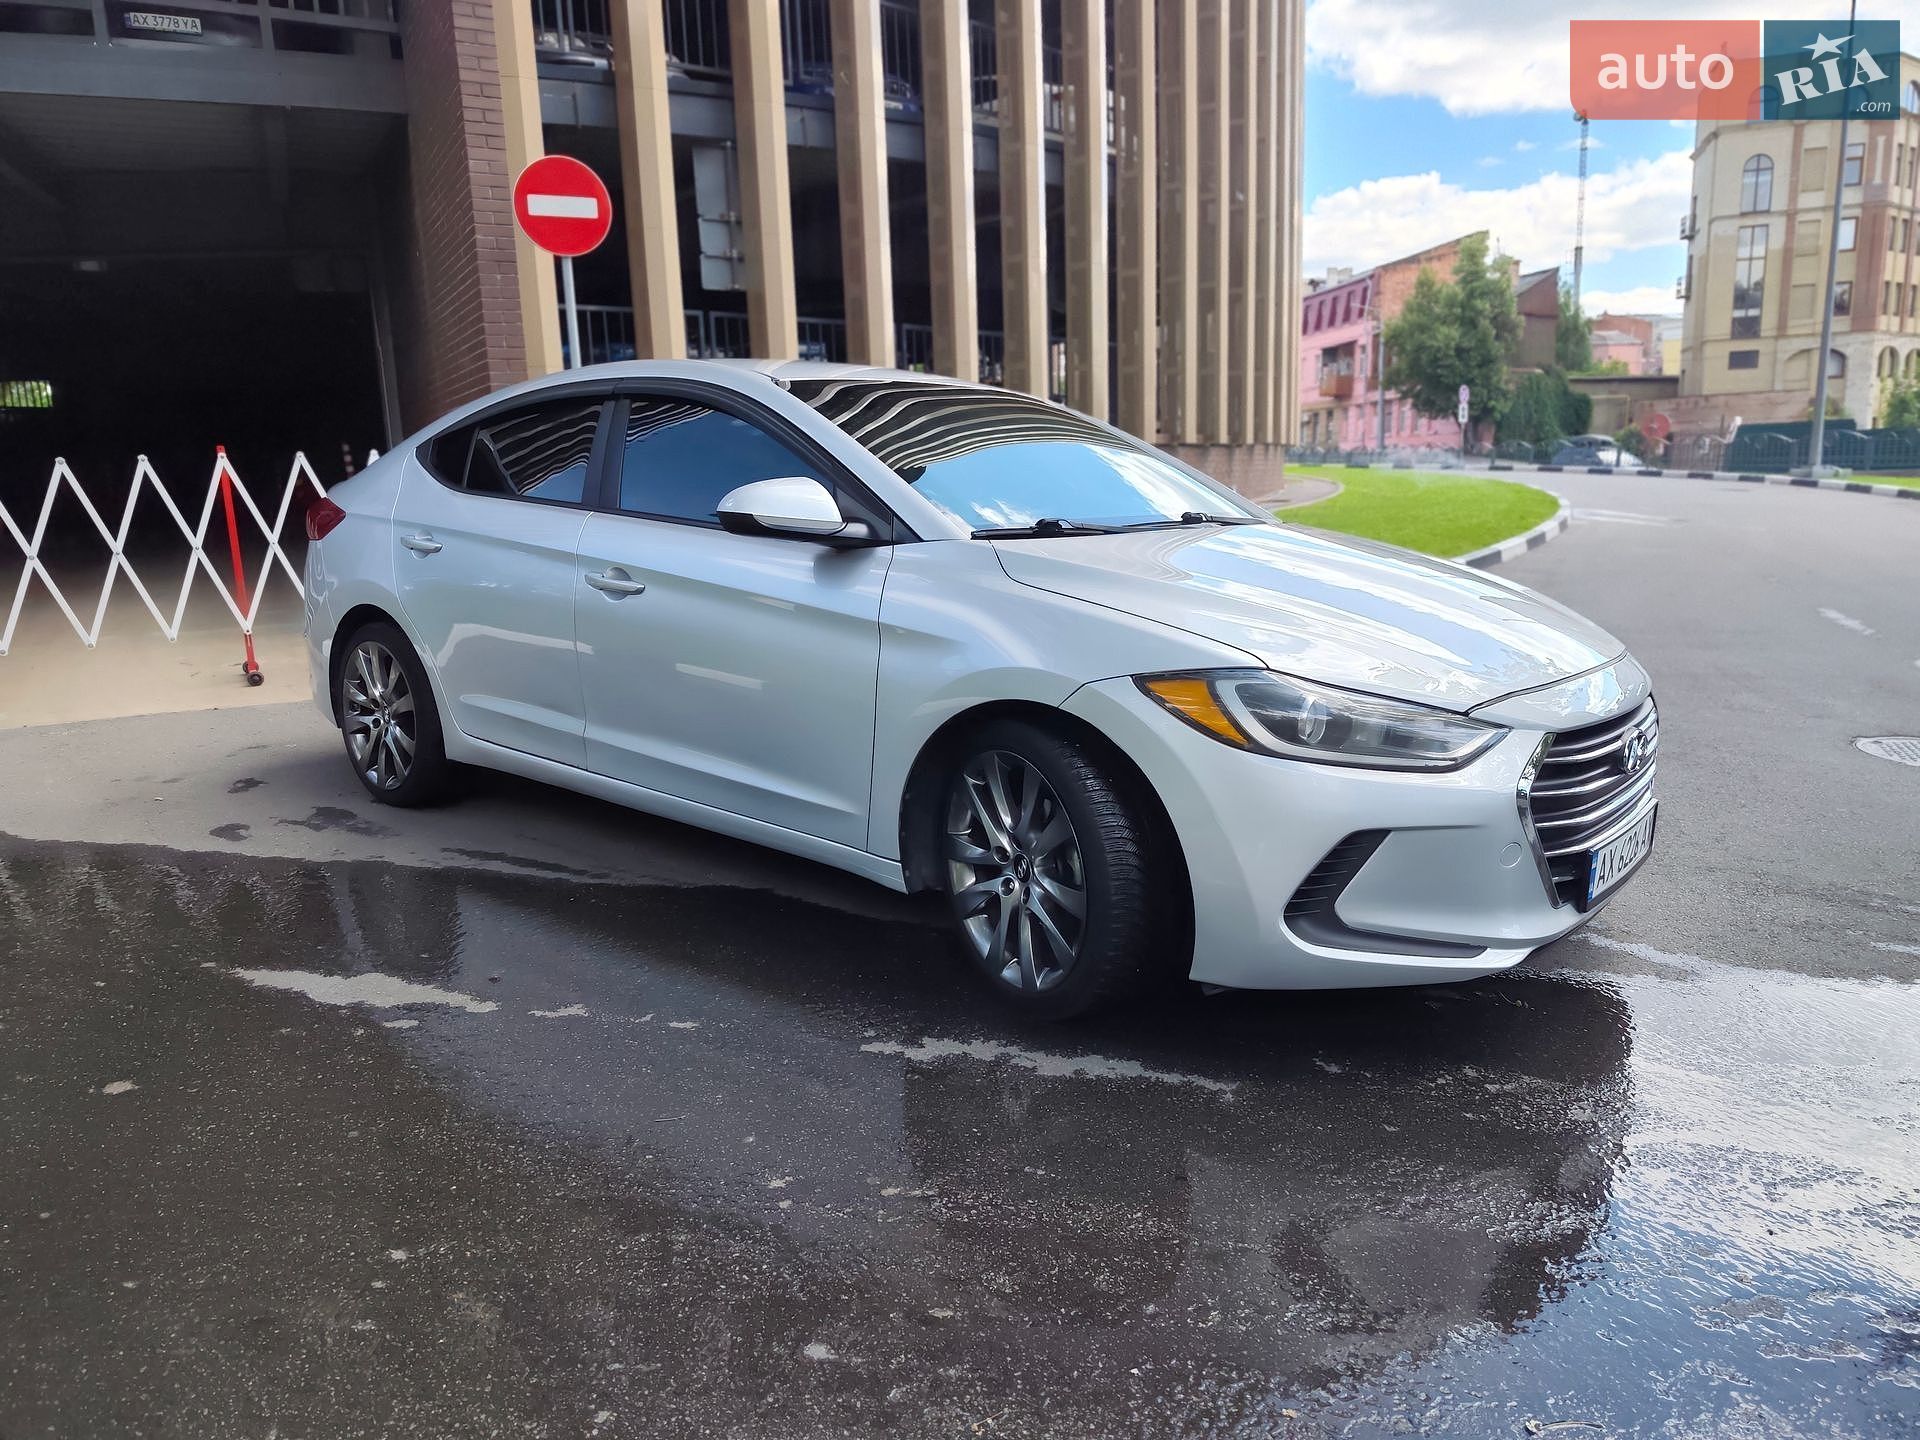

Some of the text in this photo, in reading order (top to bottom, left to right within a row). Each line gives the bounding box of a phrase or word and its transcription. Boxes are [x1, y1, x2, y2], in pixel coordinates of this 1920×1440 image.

[132, 14, 199, 31] AX 3778 YA
[1596, 845, 1618, 889] AX
